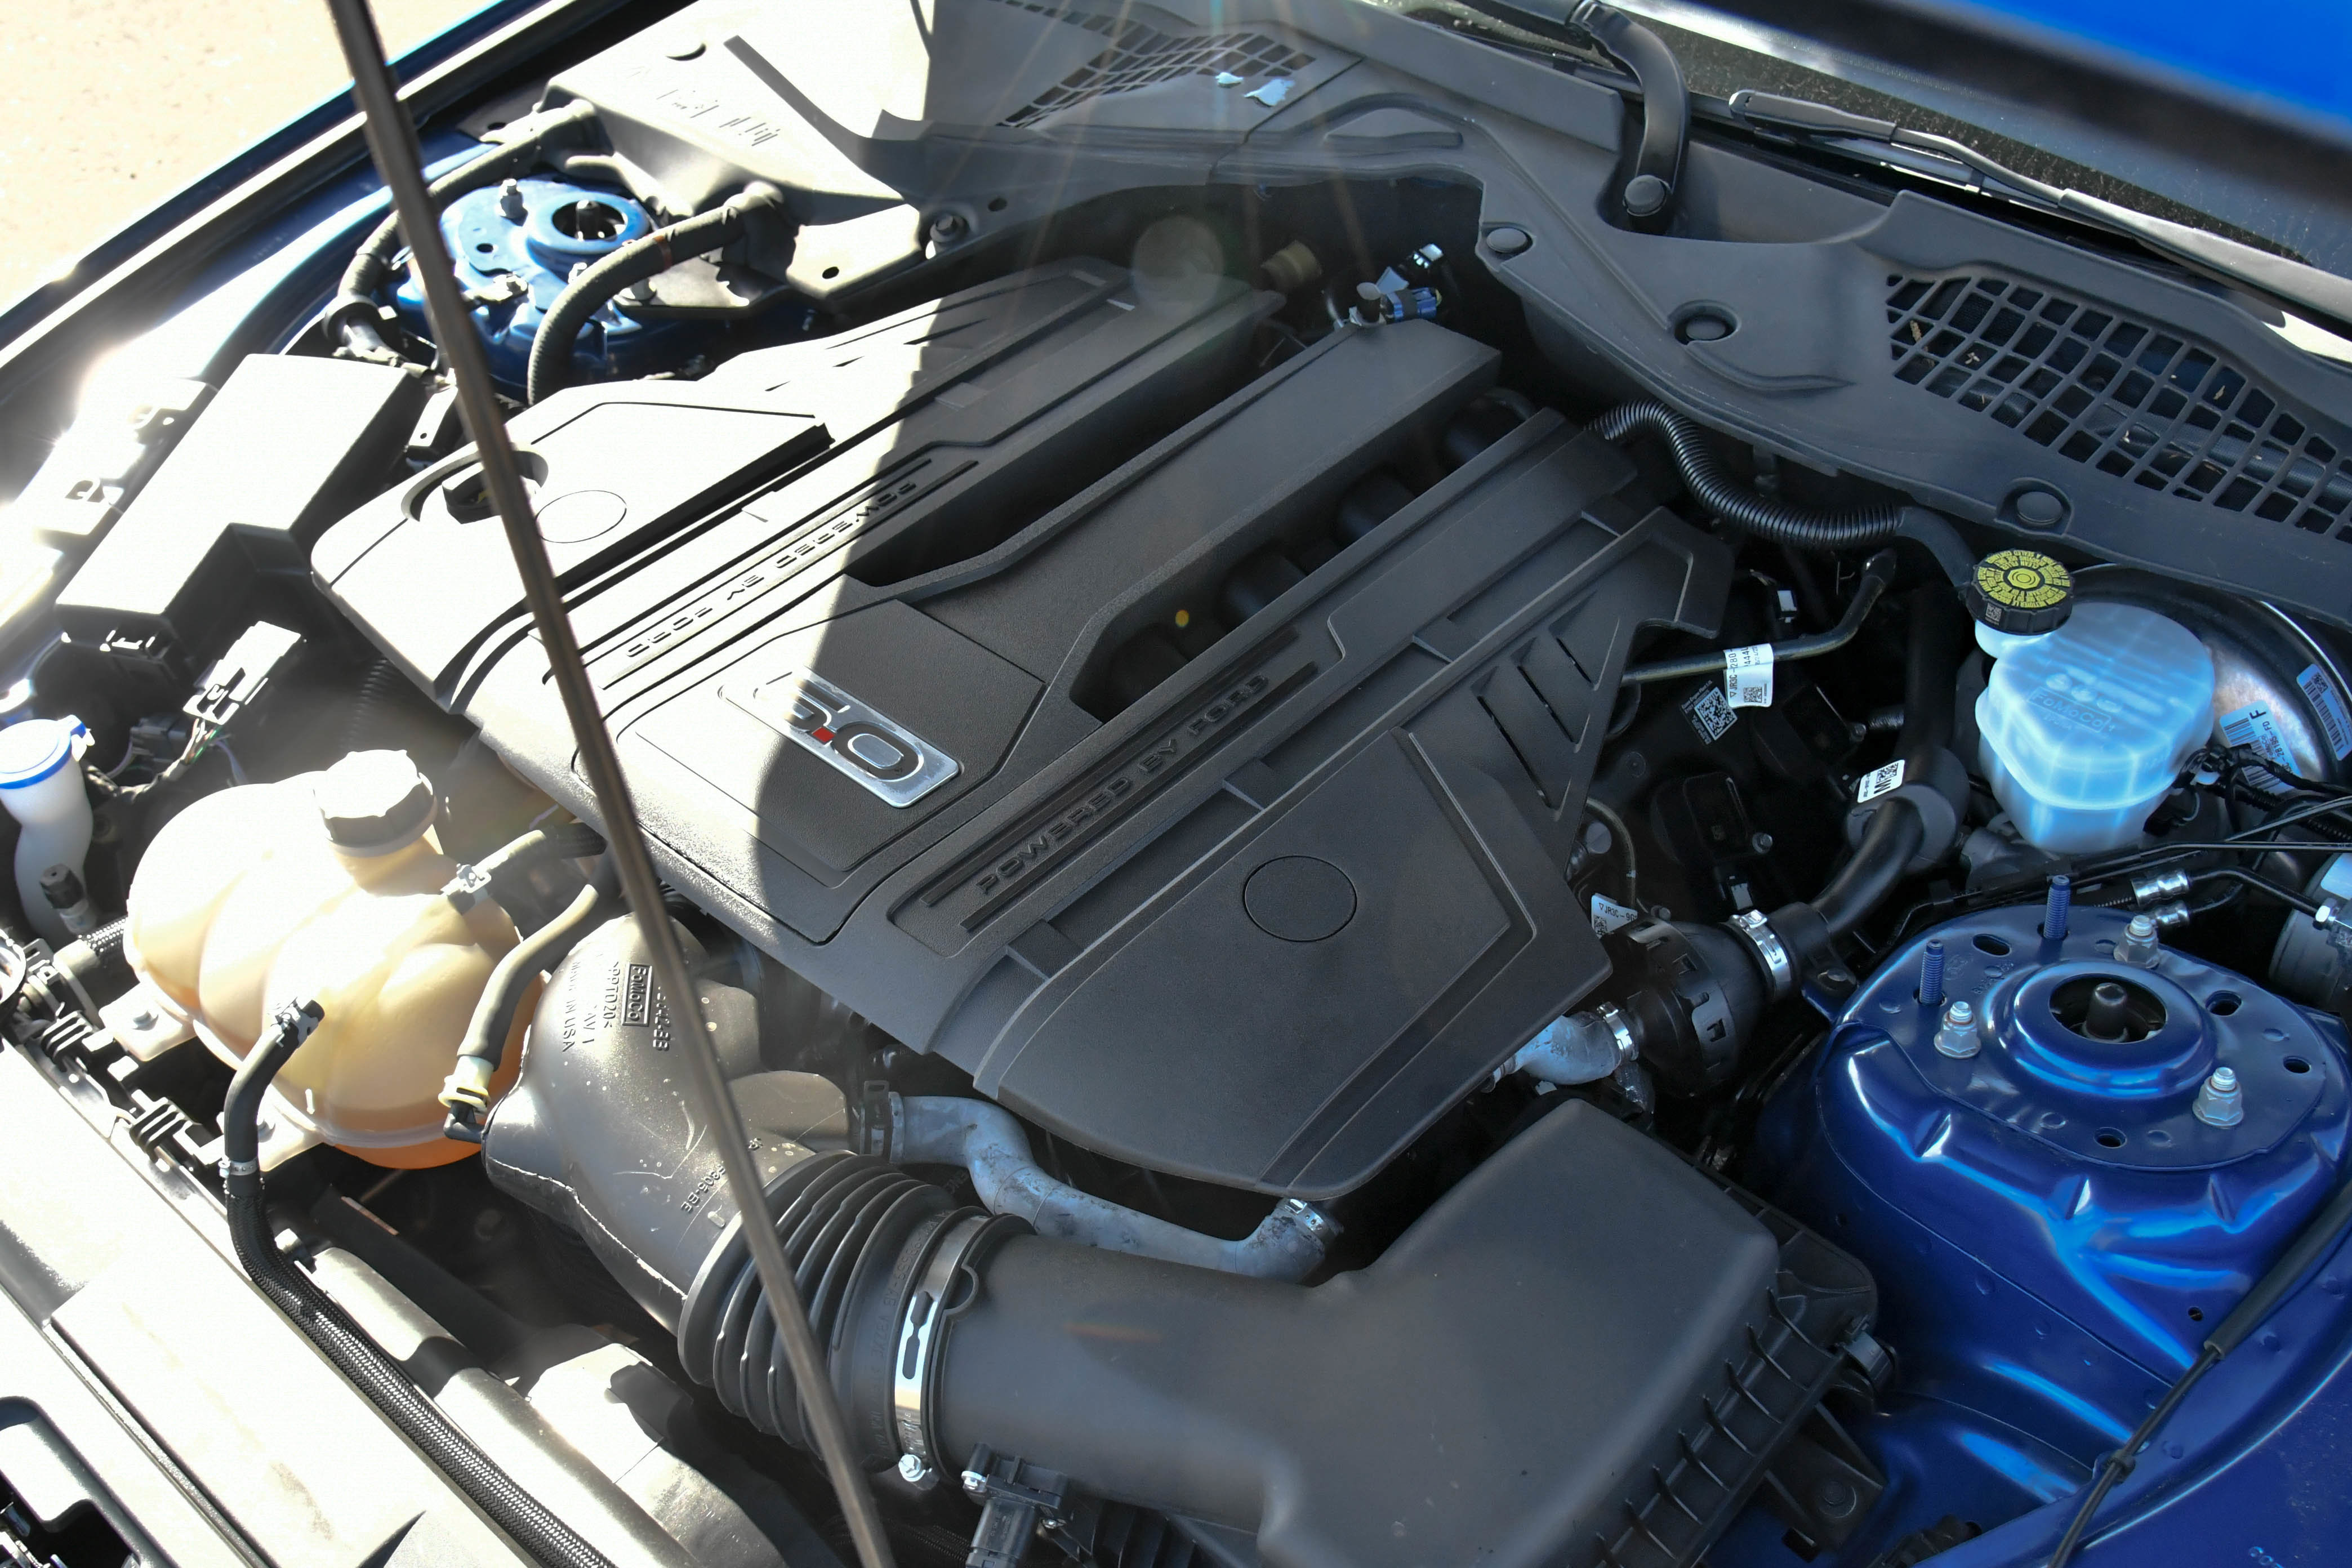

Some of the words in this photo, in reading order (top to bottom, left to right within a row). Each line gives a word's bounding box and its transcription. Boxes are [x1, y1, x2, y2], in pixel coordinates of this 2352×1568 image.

[2248, 709, 2266, 720] F
[975, 777, 1131, 894] POWERED
[1139, 738, 1178, 773] BY
[1186, 674, 1269, 736] FORD
[630, 965, 646, 1021] FoMoCo
[561, 1017, 578, 1053] USA
